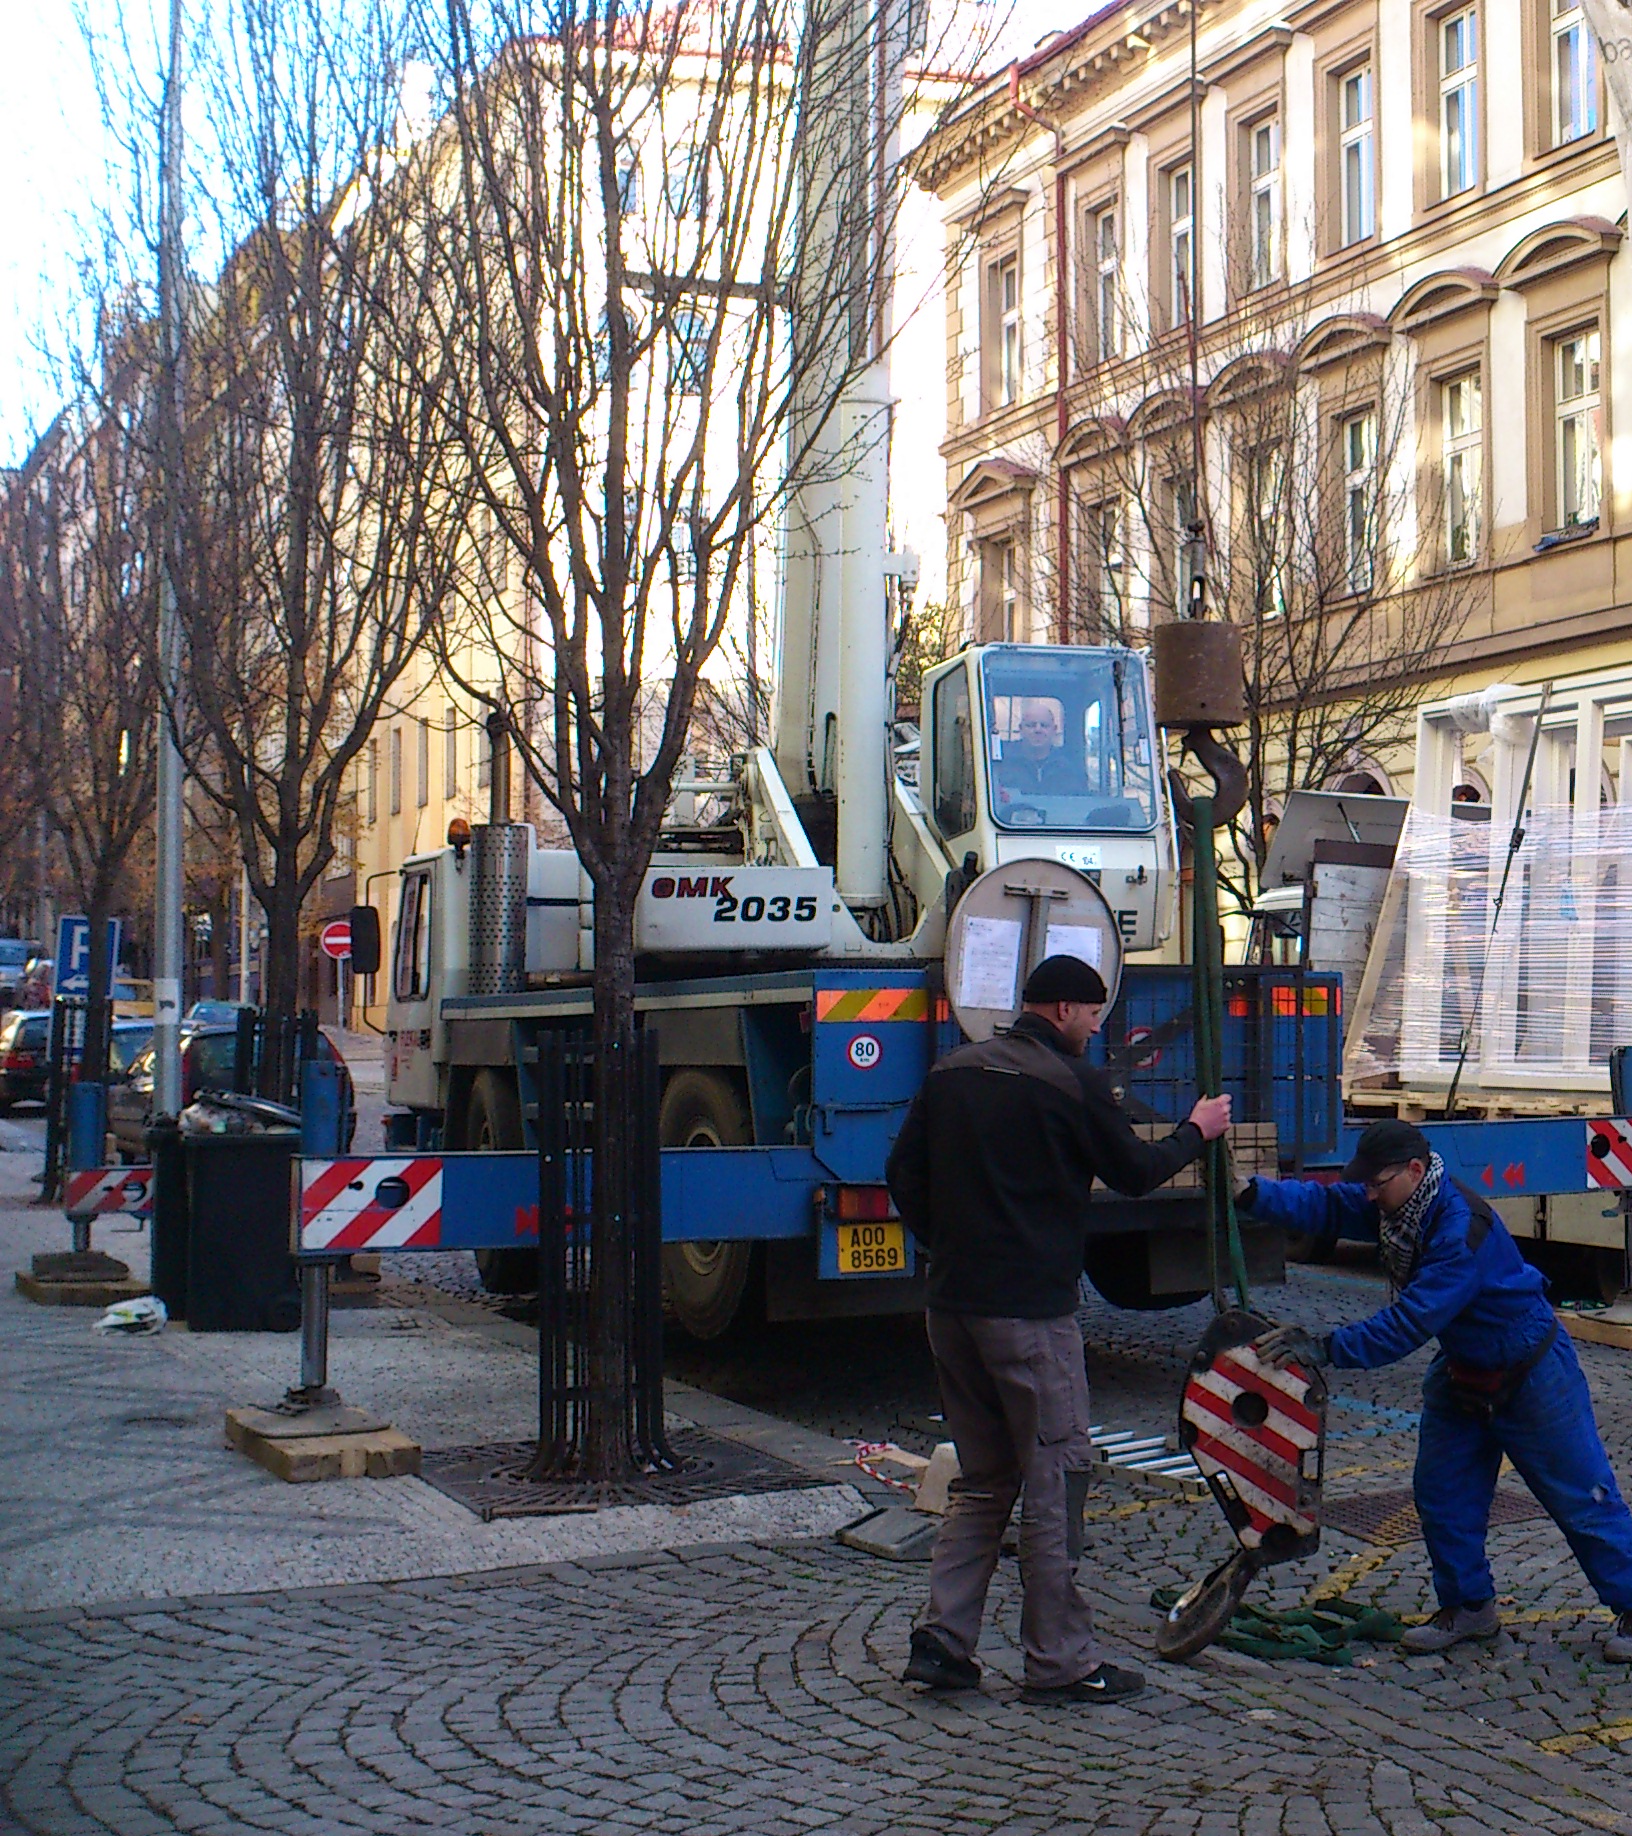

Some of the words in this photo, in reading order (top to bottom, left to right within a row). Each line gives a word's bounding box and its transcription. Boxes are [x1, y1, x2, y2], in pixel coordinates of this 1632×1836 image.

[651, 876, 735, 899] OMK
[714, 896, 818, 922] 2035
[855, 1042, 875, 1057] 80
[851, 1247, 898, 1269] 8569
